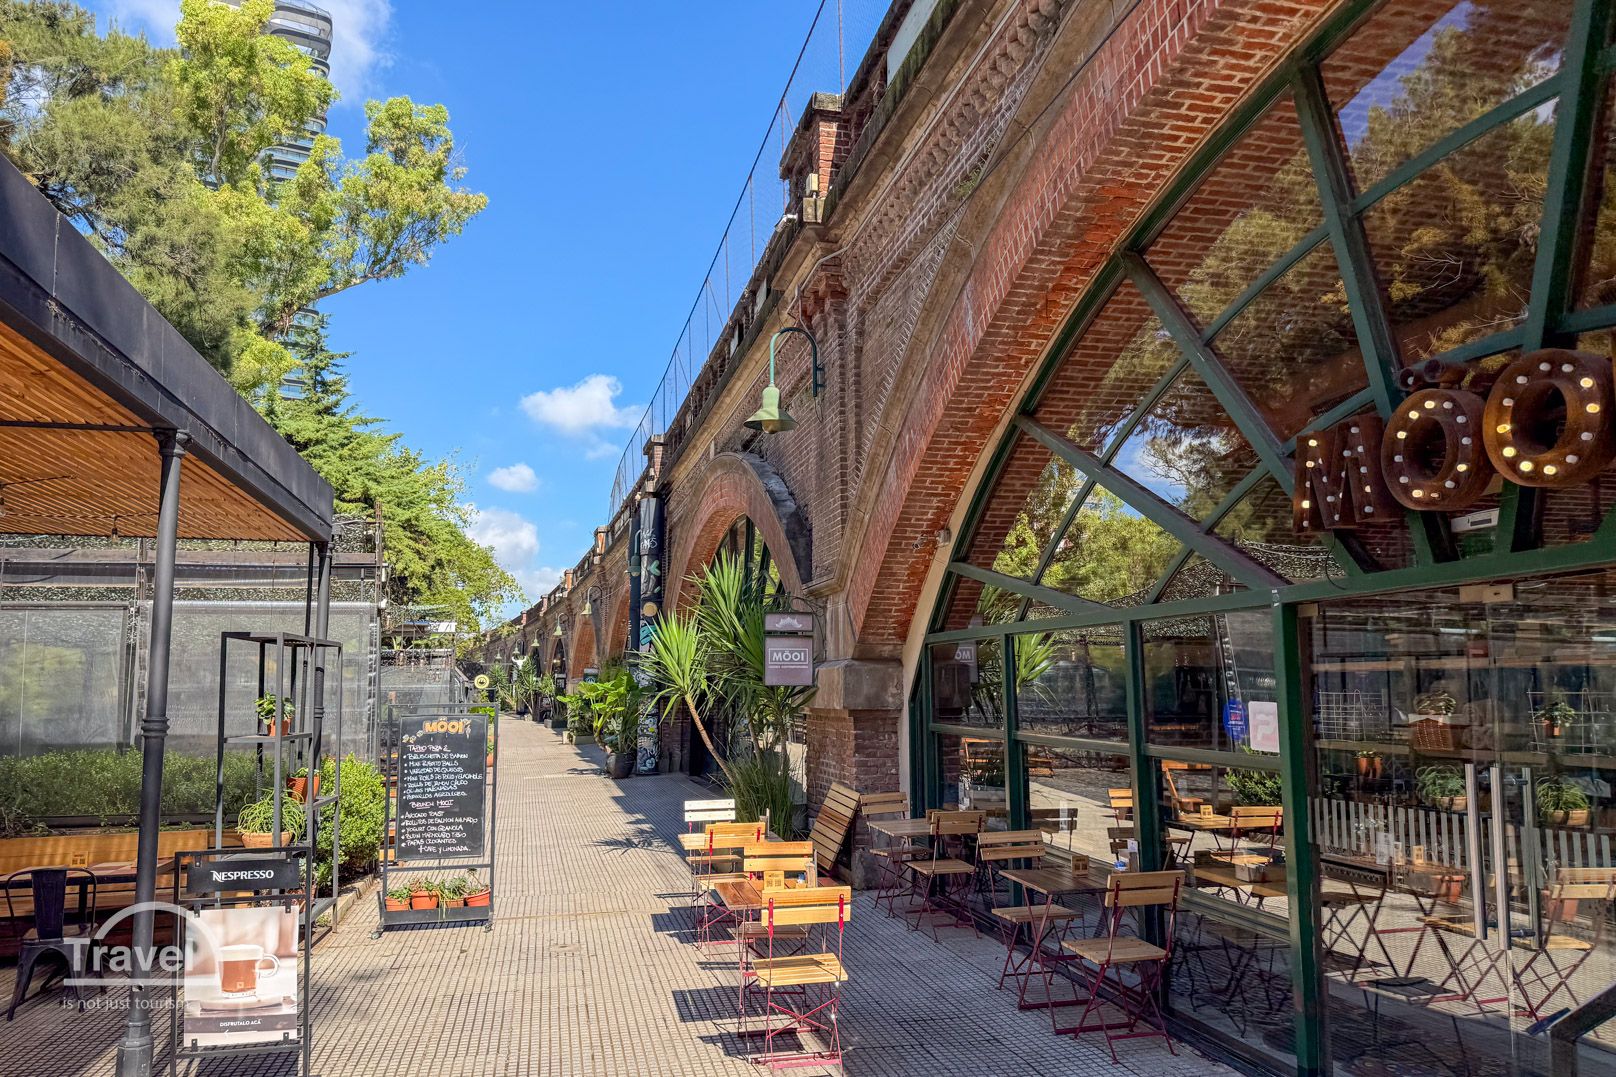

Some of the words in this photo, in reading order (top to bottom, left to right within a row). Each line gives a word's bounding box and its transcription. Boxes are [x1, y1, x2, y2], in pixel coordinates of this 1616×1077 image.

[772, 650, 805, 661] MÖOI
[443, 744, 451, 752] 2
[409, 801, 434, 809] BRUNCH
[405, 811, 427, 819] AVOCADO
[210, 869, 275, 883] NESPRESSO
